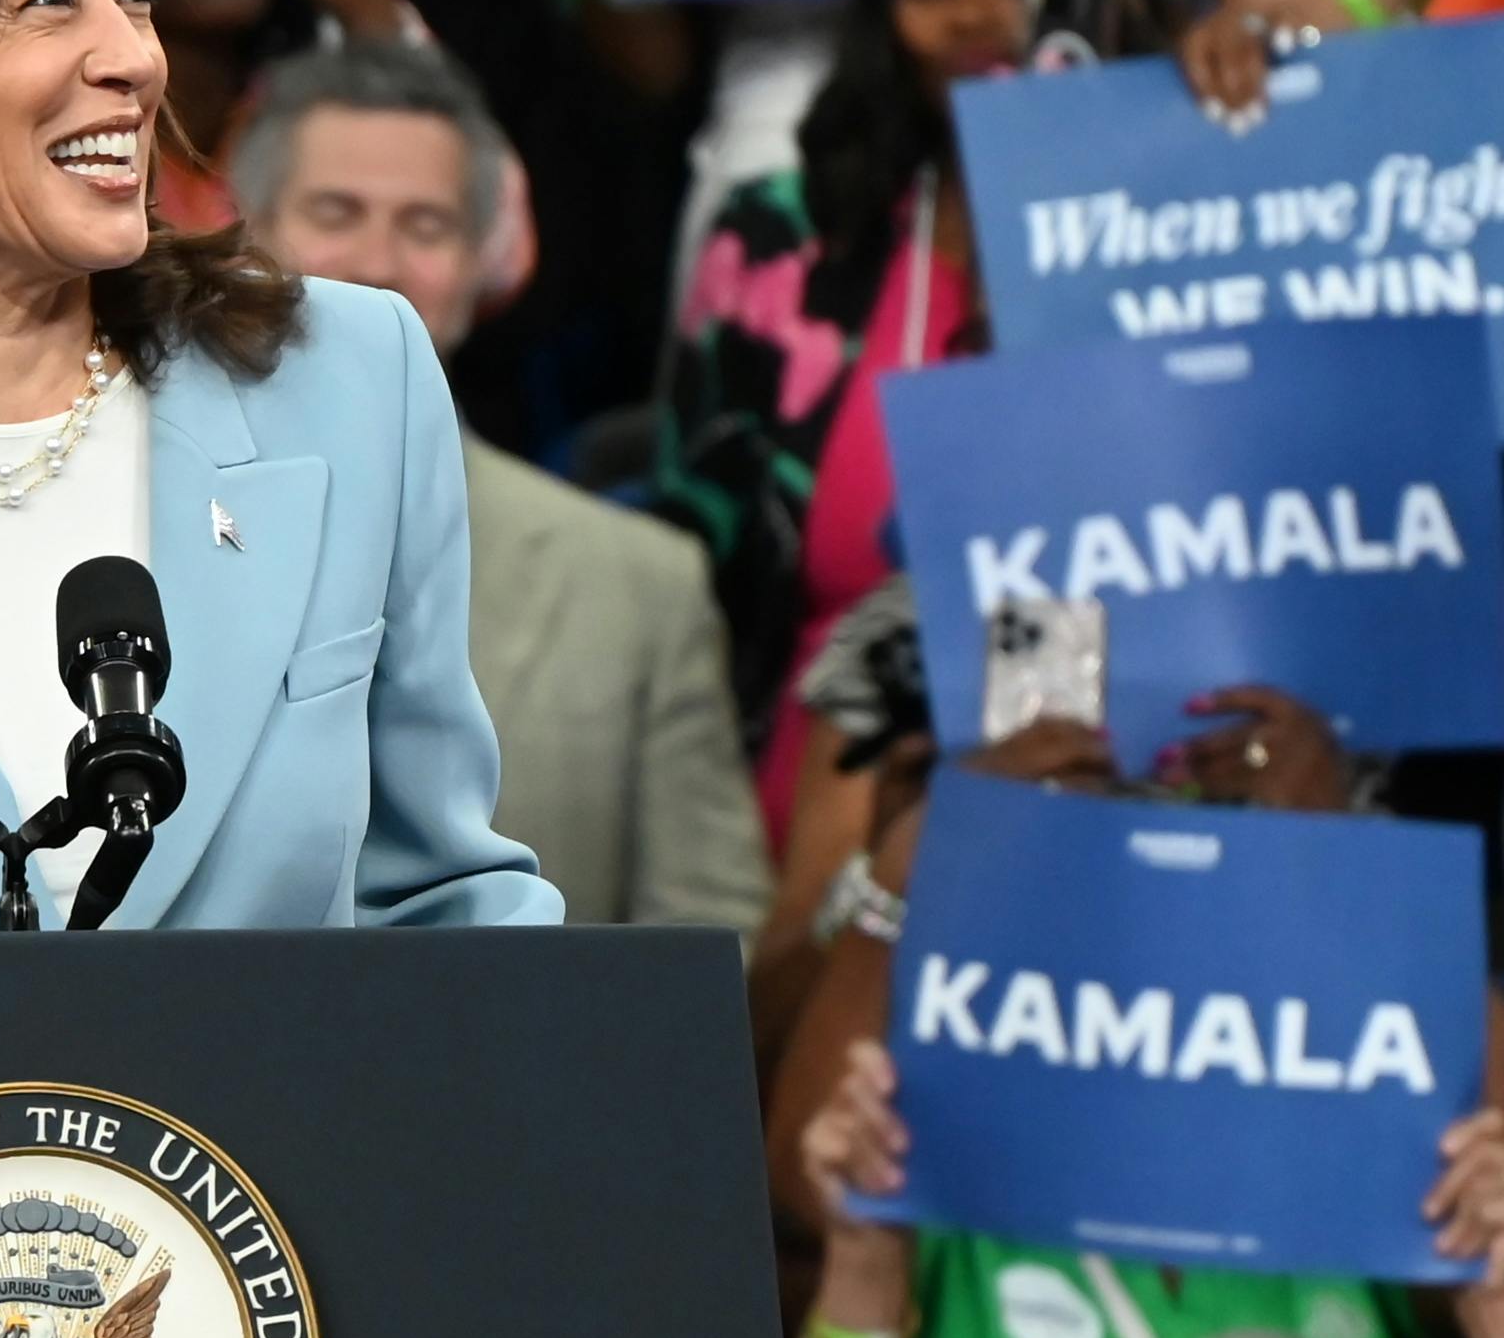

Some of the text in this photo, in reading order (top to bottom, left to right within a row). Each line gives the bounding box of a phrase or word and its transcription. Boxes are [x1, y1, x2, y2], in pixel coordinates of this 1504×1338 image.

[1026, 190, 1241, 275] When
[1253, 183, 1357, 250] we
[1113, 275, 1265, 339] WE
[967, 483, 1463, 616] KAMALA
[913, 954, 1435, 1094] KAMALA
[25, 1106, 121, 1155] THE
[57, 1287, 102, 1303] UNUM
